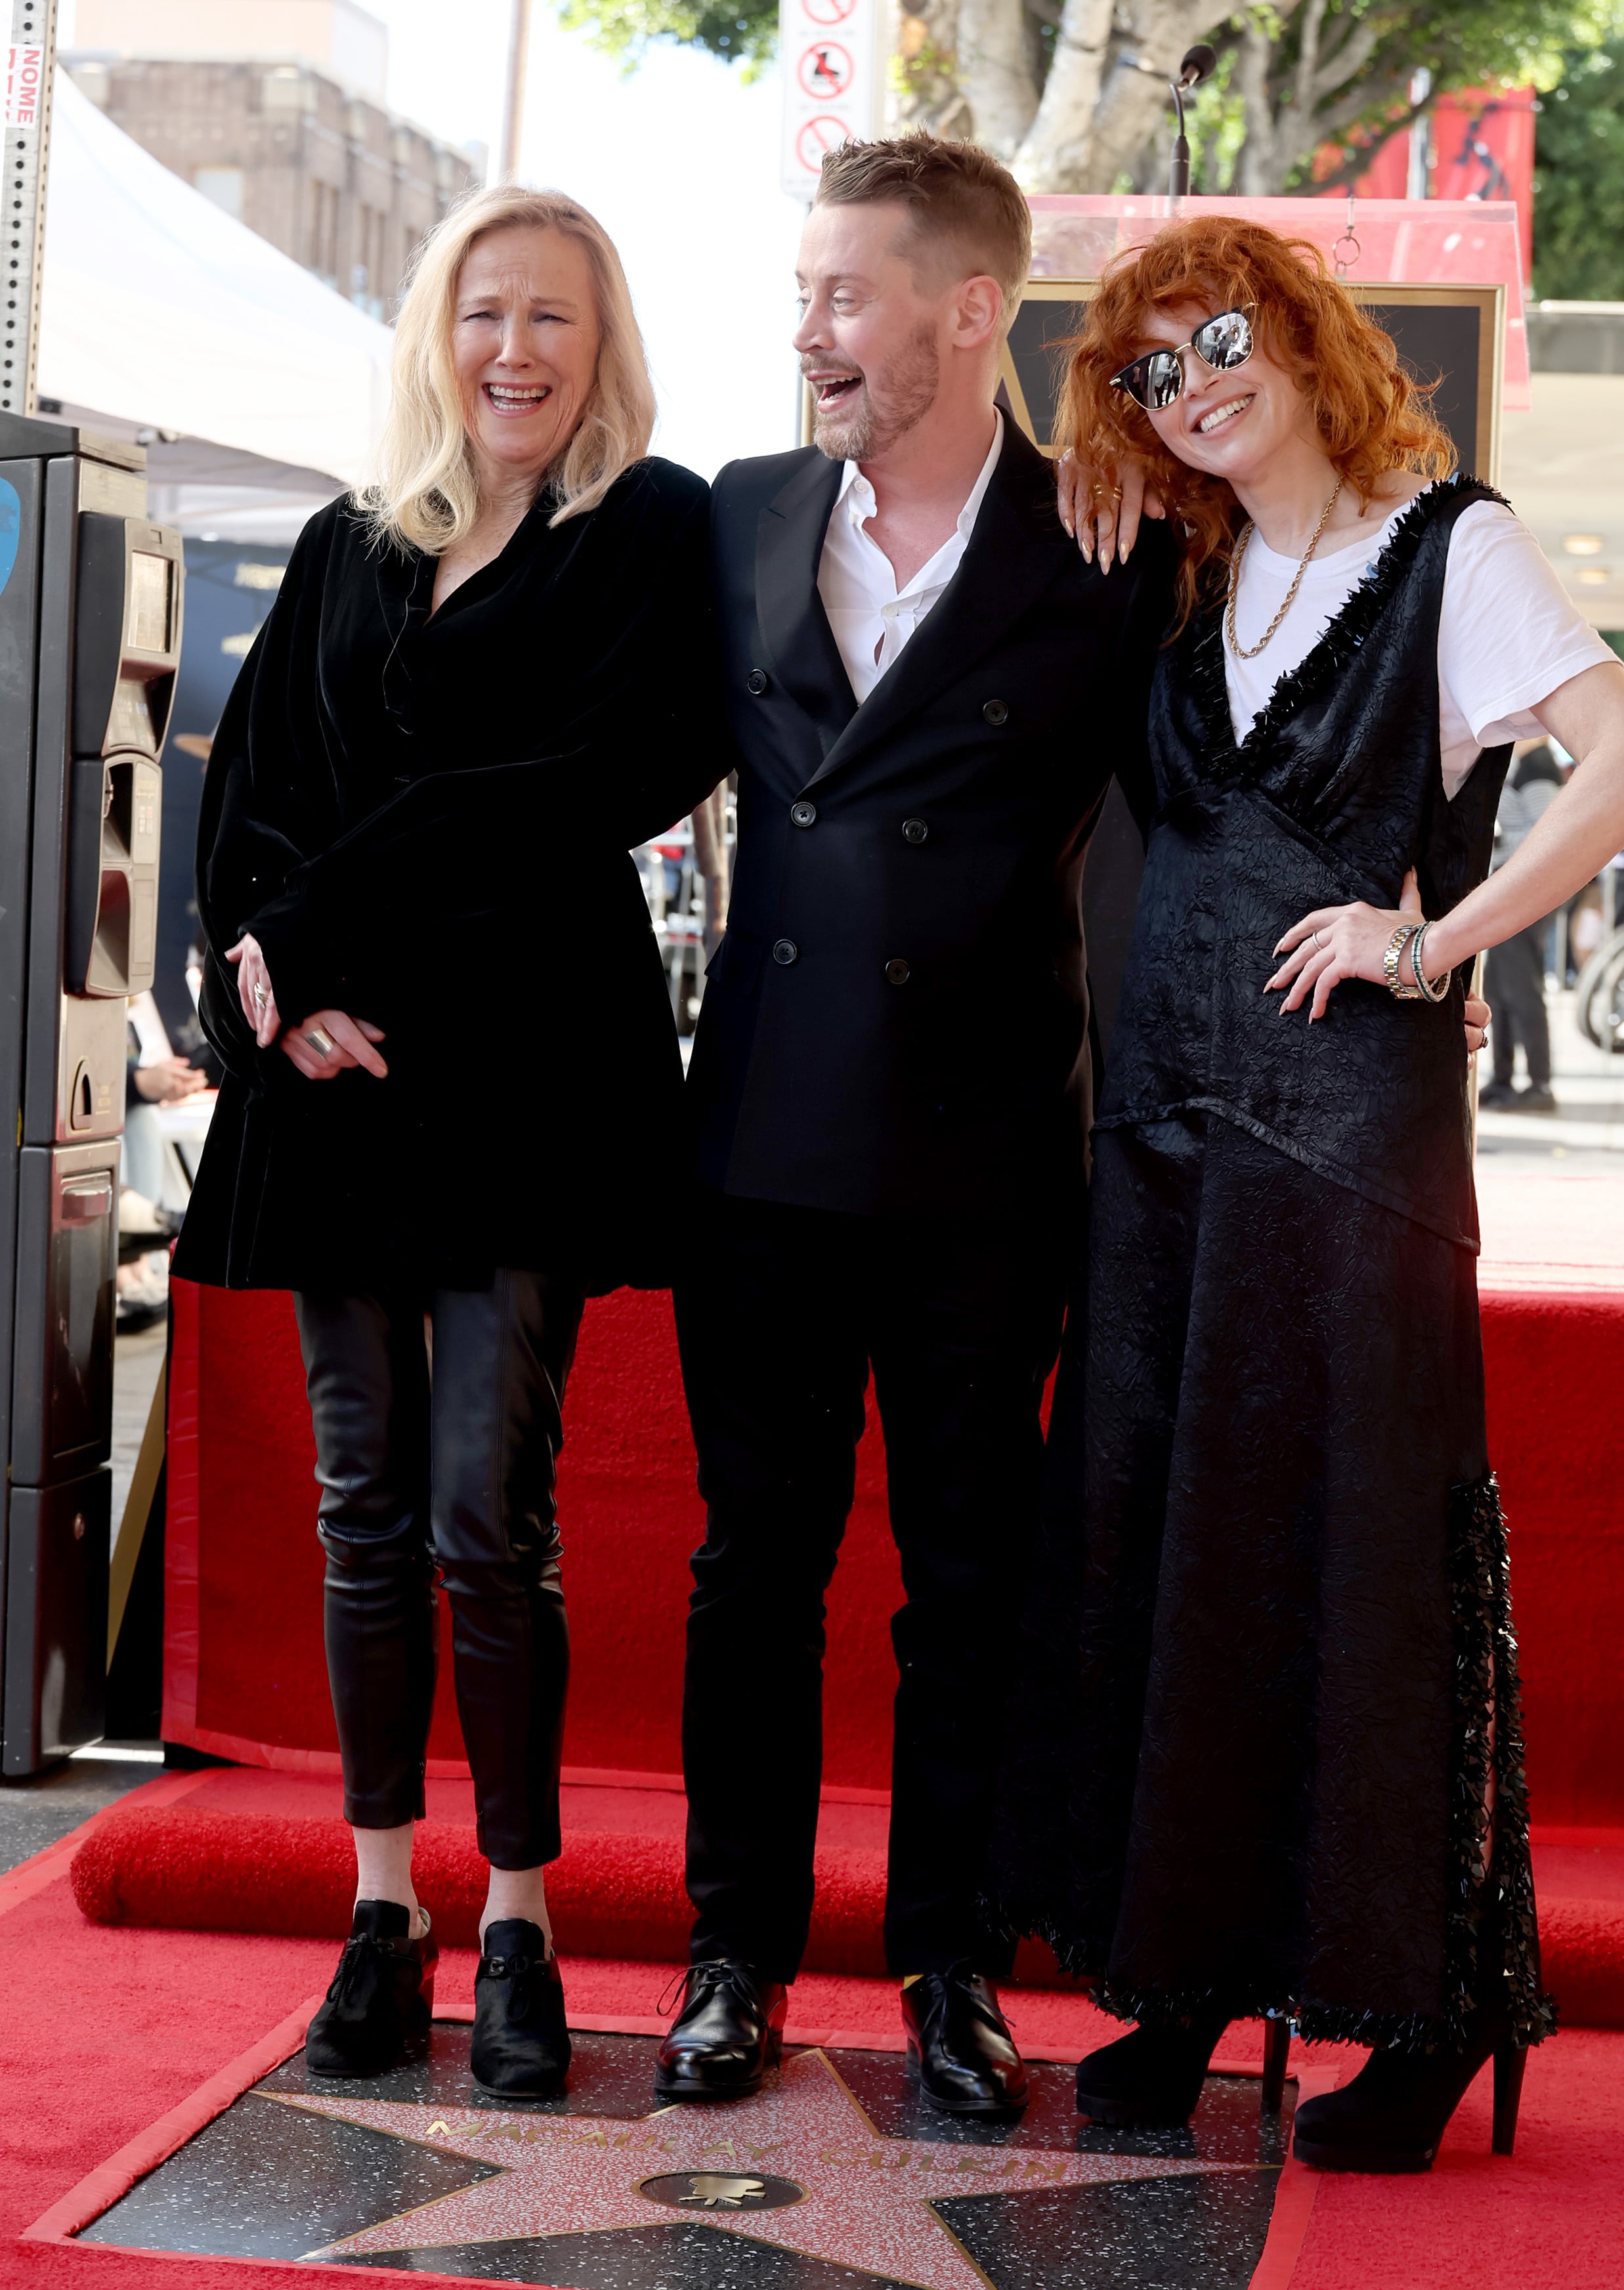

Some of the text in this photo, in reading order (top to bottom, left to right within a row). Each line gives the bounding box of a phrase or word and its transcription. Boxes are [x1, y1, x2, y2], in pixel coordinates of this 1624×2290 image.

[17, 49, 40, 123] NOME
[425, 2119, 1067, 2180] MACAULAY CULKIN
